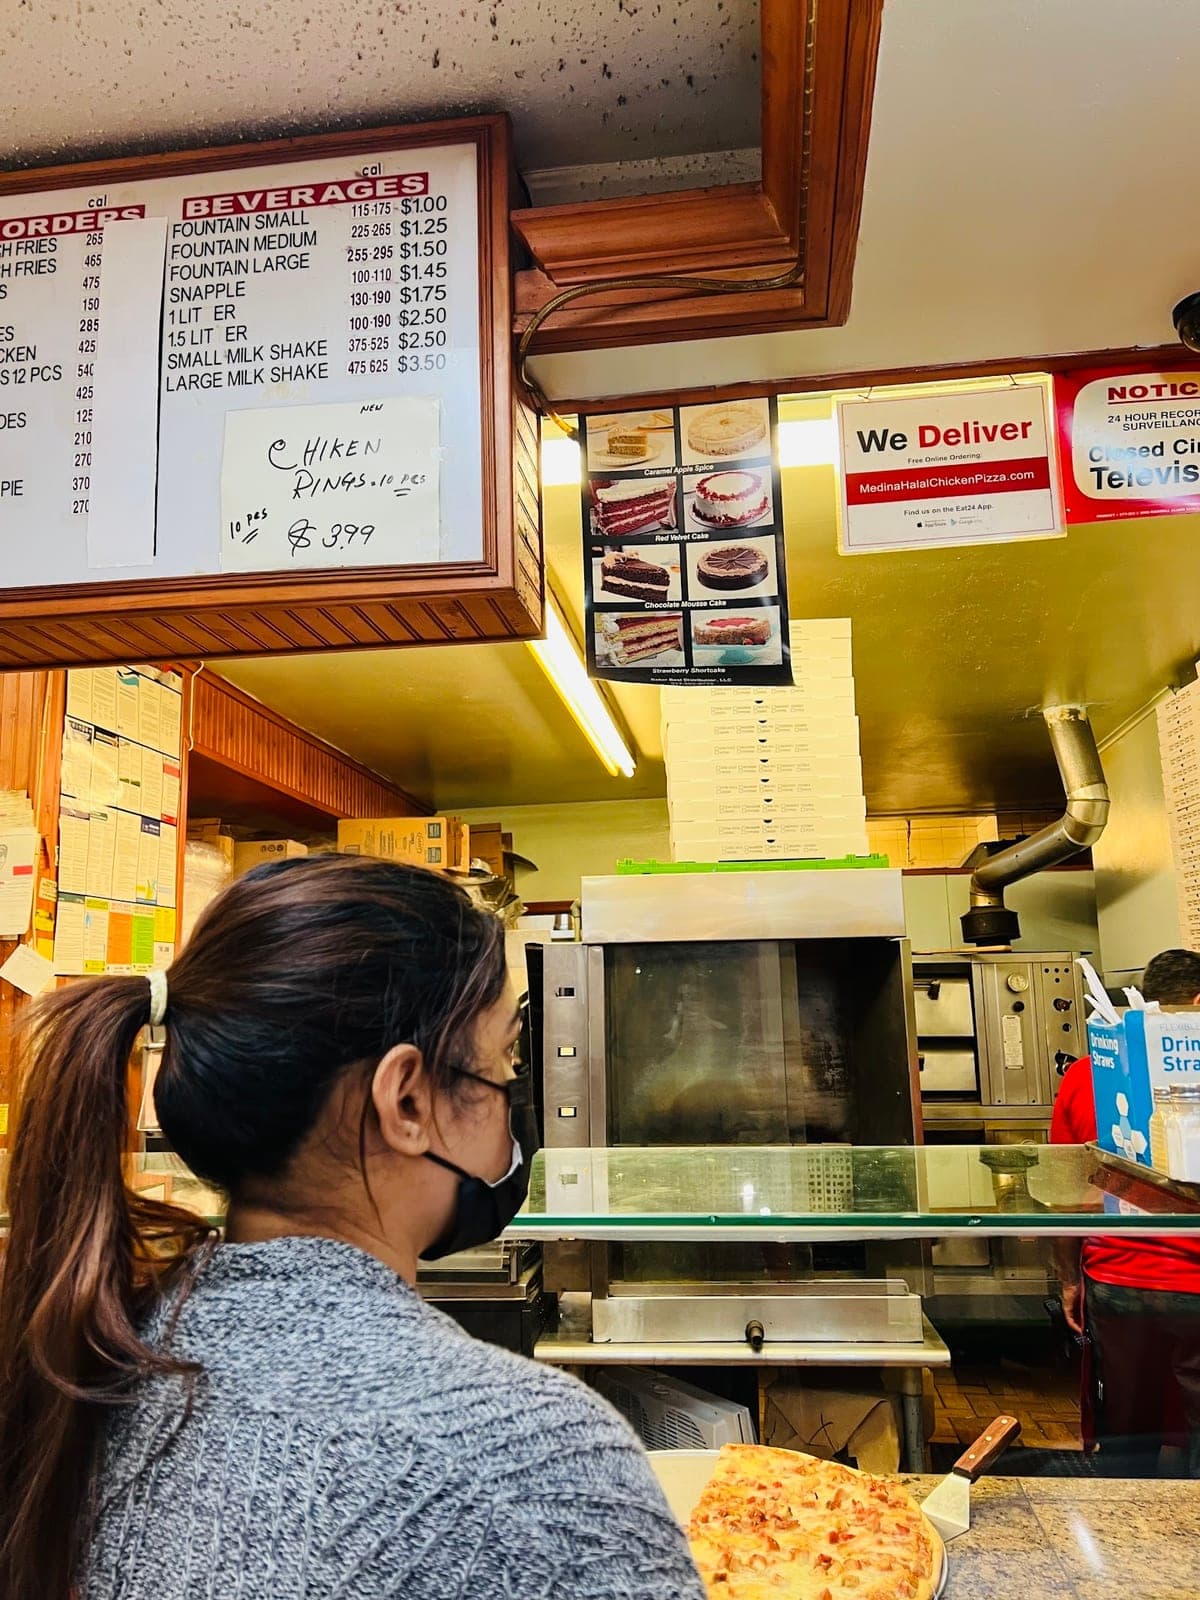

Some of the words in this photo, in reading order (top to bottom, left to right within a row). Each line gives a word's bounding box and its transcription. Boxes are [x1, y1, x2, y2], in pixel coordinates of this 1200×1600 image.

[362, 162, 382, 176] cal
[88, 194, 107, 208] cal
[186, 175, 425, 217] BEVERAGES
[172, 216, 250, 239] FOUNTAIN
[255, 210, 309, 230] SMALL
[400, 196, 447, 215] $1.00
[16, 238, 57, 256] FRIES
[86, 232, 103, 246] 265
[171, 237, 249, 260] FOUNTAIN
[254, 231, 317, 251] MEDIUM
[351, 223, 391, 238] 225-265
[400, 218, 447, 237] $1.25
[15, 258, 57, 277] FRIES
[84, 255, 102, 268] 465
[170, 259, 248, 282] FOUNTAIN
[253, 253, 310, 273] LARGE
[347, 245, 393, 262] 255-295
[400, 240, 447, 259] $1.50
[82, 276, 100, 289] 475
[169, 281, 246, 303] SNAPPLE
[352, 268, 392, 284] 100-110
[400, 262, 447, 282] $1.45
[82, 298, 100, 311] 150
[169, 310, 175, 326] 1
[350, 291, 391, 306] 130-190
[400, 284, 447, 305] $1.75
[79, 319, 99, 332] 285
[349, 314, 391, 330] 100-190
[399, 307, 447, 328] $2.50
[78, 340, 96, 353] 425
[167, 349, 222, 370] SMALL
[227, 345, 264, 364] MILK
[269, 340, 328, 361] SHAKE
[348, 336, 389, 352] 375-525
[398, 330, 446, 351] $2.50
[30, 365, 62, 383] PCS
[166, 371, 223, 393] LARGE
[227, 367, 264, 387] MILK
[270, 363, 329, 384] SHAKE
[397, 353, 446, 373] $3.50
[76, 386, 94, 399] 425
[76, 409, 93, 423] 125
[360, 403, 383, 414] NEW
[1124, 412, 1157, 421] HOUR
[74, 431, 92, 445] 210
[856, 428, 908, 453] We
[918, 420, 1033, 448] Deliver
[74, 452, 92, 466] 270
[907, 457, 923, 465] Free
[924, 455, 948, 463] Online
[1089, 441, 1164, 462] Closed
[644, 466, 673, 476] Caramel
[674, 465, 693, 474] Apple
[694, 463, 714, 472] Spice
[1089, 460, 1200, 490] Televis
[0, 480, 24, 497] PIE
[72, 476, 90, 491] 370
[859, 470, 1035, 494] MedinaHalalChickenPizza.com
[956, 504, 976, 512] Eat24
[230, 521, 241, 539] 10
[246, 508, 268, 526] pcs
[670, 533, 690, 541] Velvet
[691, 532, 709, 540] Cake
[644, 600, 680, 609] Chocolate
[680, 600, 708, 608] Mousse
[708, 599, 727, 607] Cake
[652, 667, 690, 675] Strawberry
[1090, 1031, 1119, 1056] Drinking
[1092, 1049, 1115, 1069] Straws
